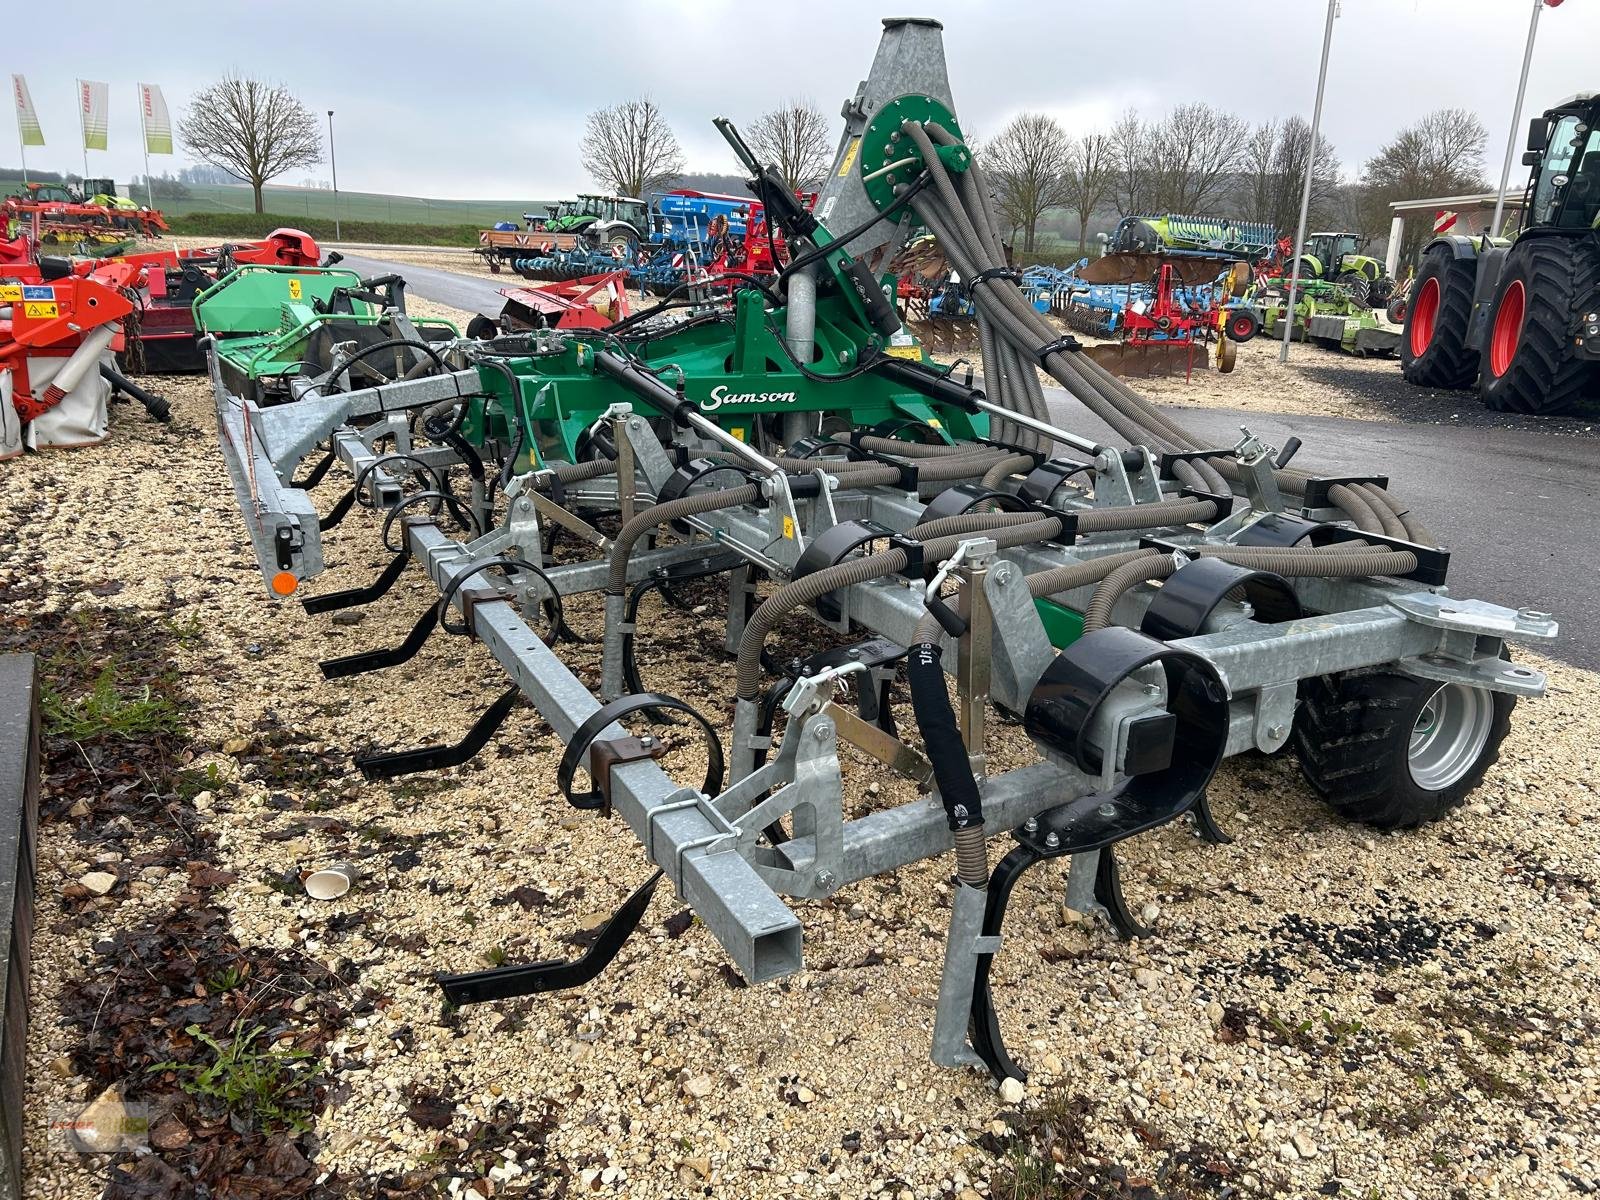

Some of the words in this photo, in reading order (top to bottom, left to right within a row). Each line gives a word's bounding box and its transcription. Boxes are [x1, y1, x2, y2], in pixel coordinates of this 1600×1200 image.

[82, 84, 91, 113] CLAAS
[144, 87, 153, 117] CLAAS
[700, 385, 797, 411] Samson
